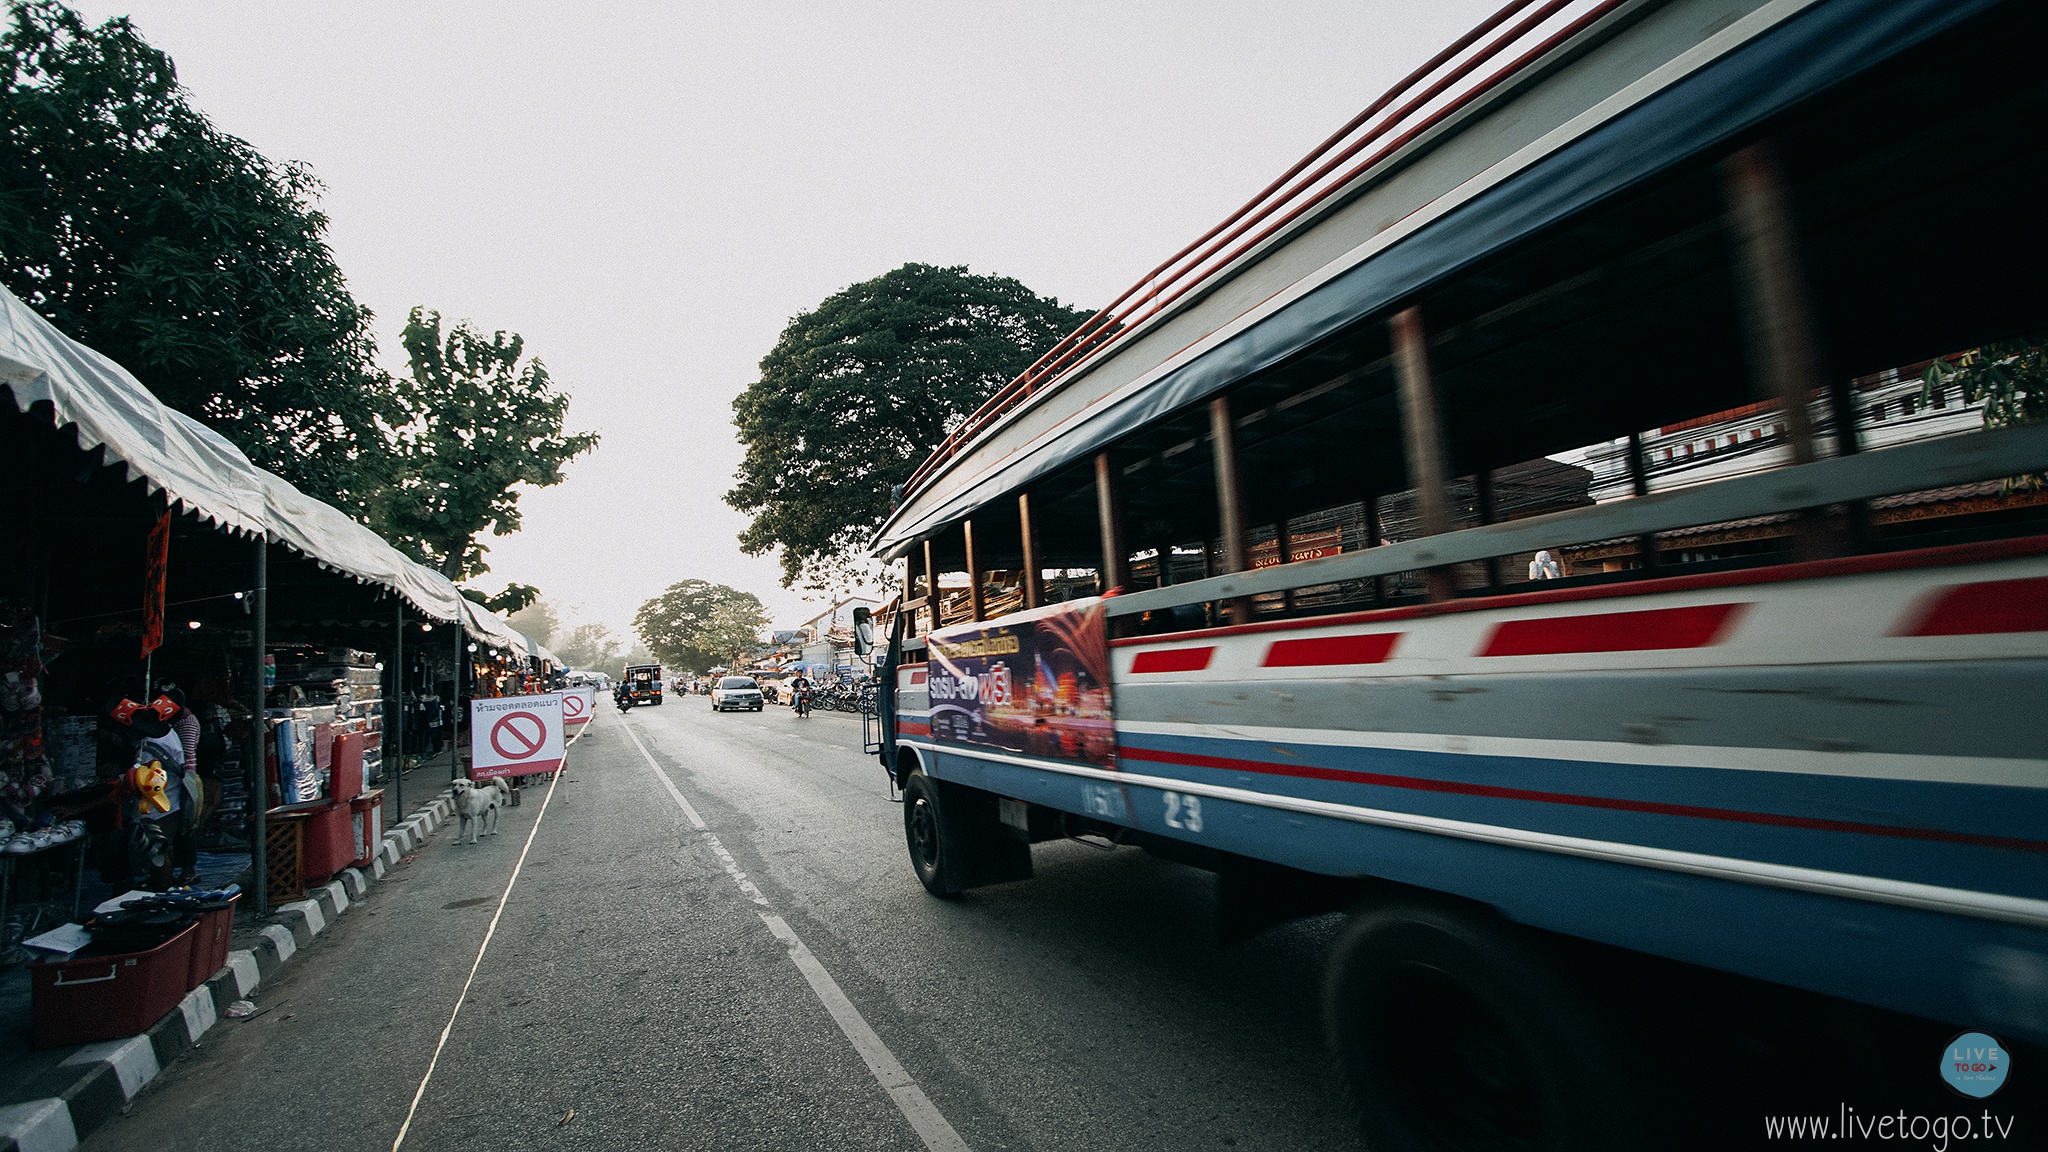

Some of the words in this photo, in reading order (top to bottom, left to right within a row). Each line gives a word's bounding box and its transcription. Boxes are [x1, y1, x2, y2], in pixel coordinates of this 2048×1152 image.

[476, 699, 558, 713] ห้ามจอดตลอดแนว
[1162, 791, 1204, 833] 23
